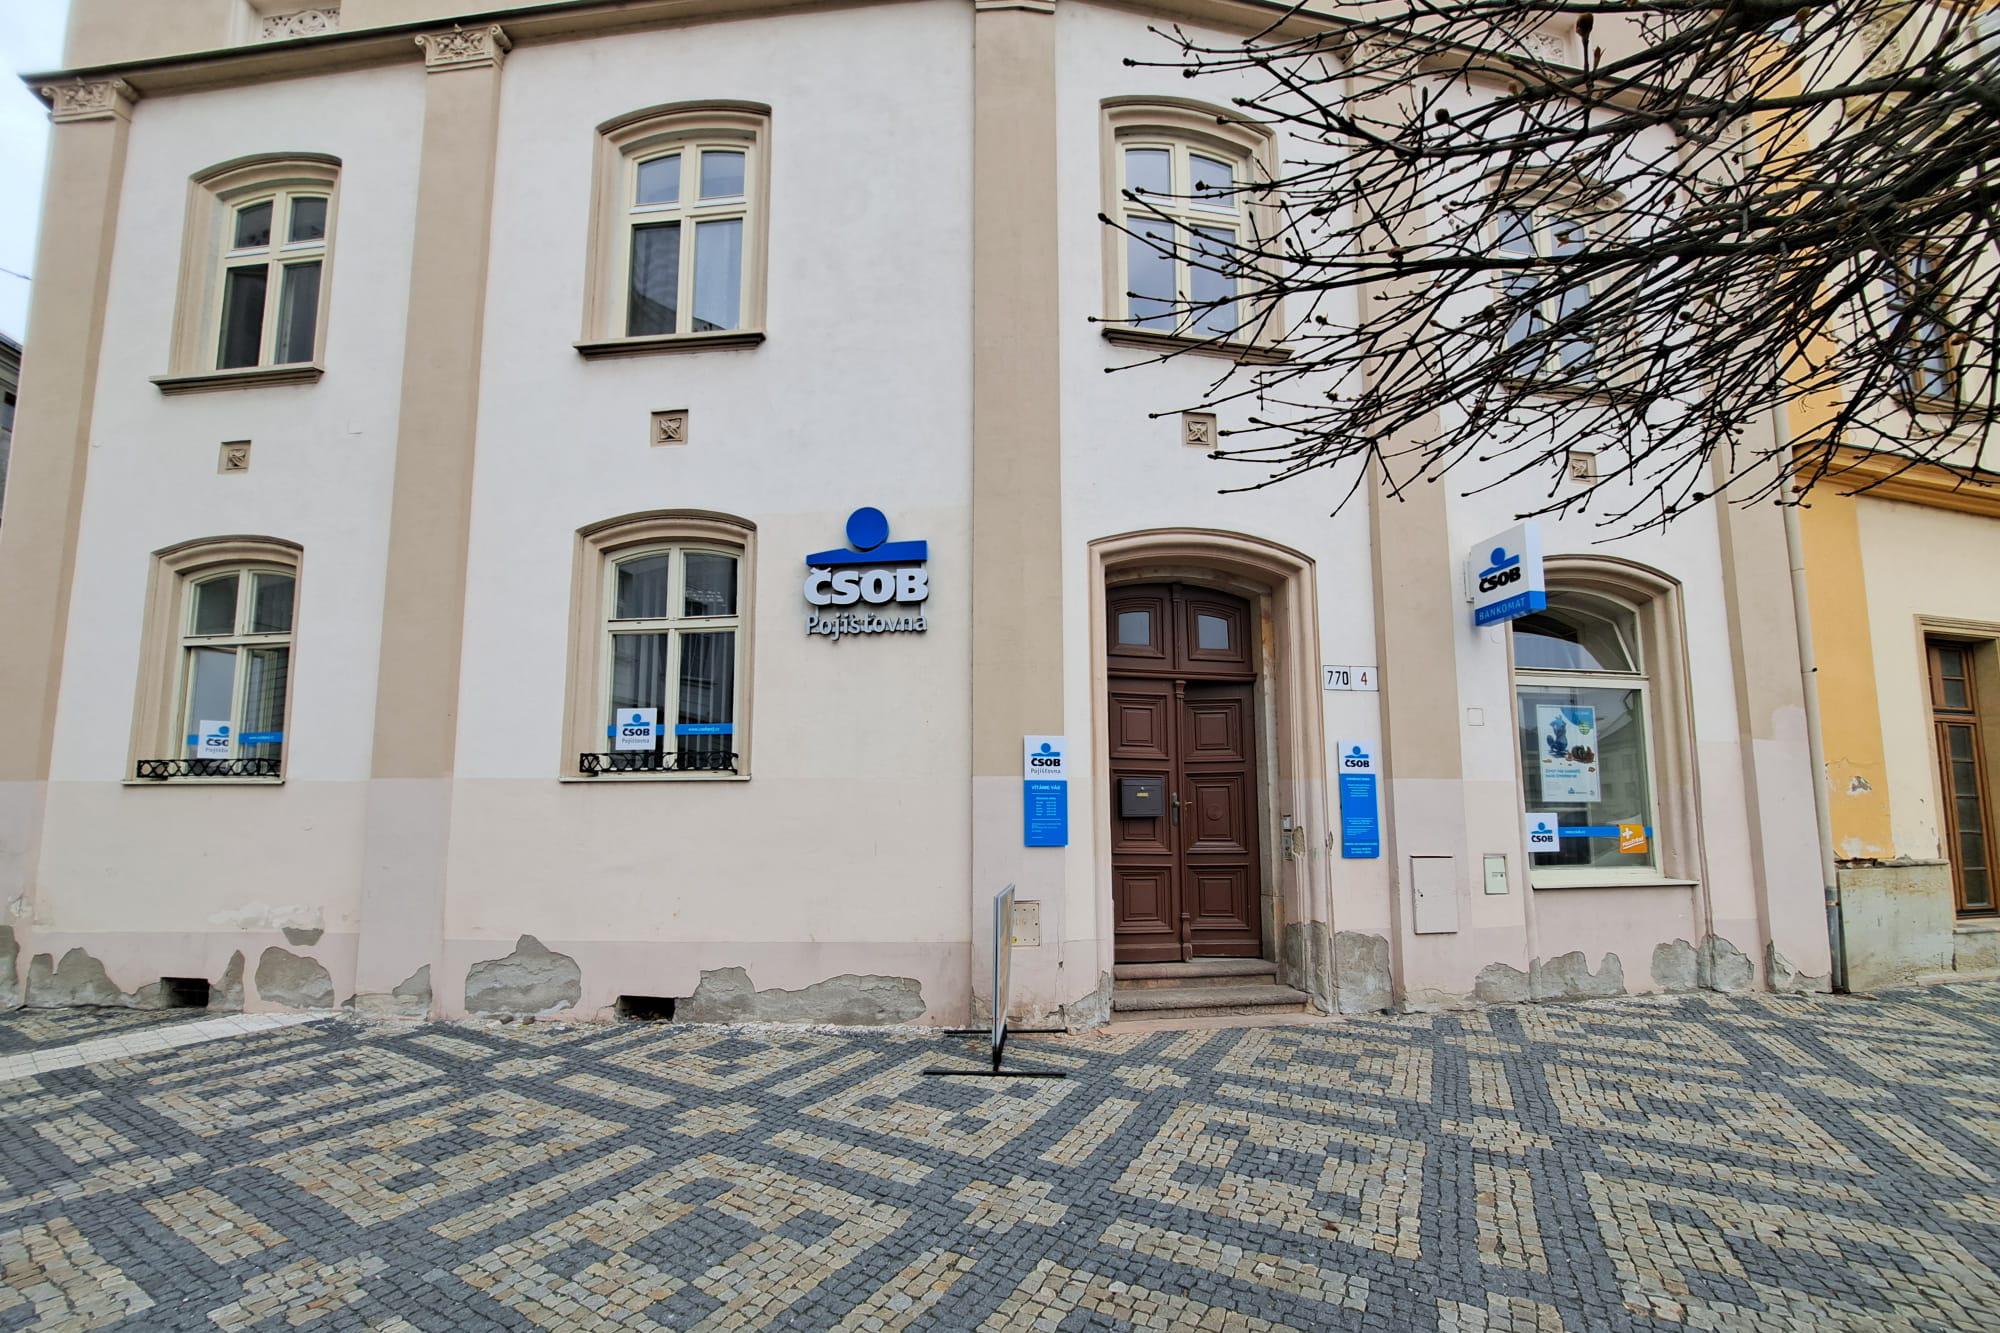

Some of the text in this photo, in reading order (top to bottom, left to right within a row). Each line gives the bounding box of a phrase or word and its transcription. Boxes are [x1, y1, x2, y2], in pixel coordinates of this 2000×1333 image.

[804, 567, 929, 606] ČSOB
[1479, 566, 1521, 593] ČSOB
[1479, 597, 1526, 621] BANKOMAT
[806, 612, 928, 641] Pojišťovna
[1327, 670, 1368, 686] 770 4
[622, 728, 650, 737] ČSOB
[1030, 757, 1061, 767] ČSOB
[1344, 759, 1370, 768] ČSOB
[1531, 835, 1553, 843] ČSOB
